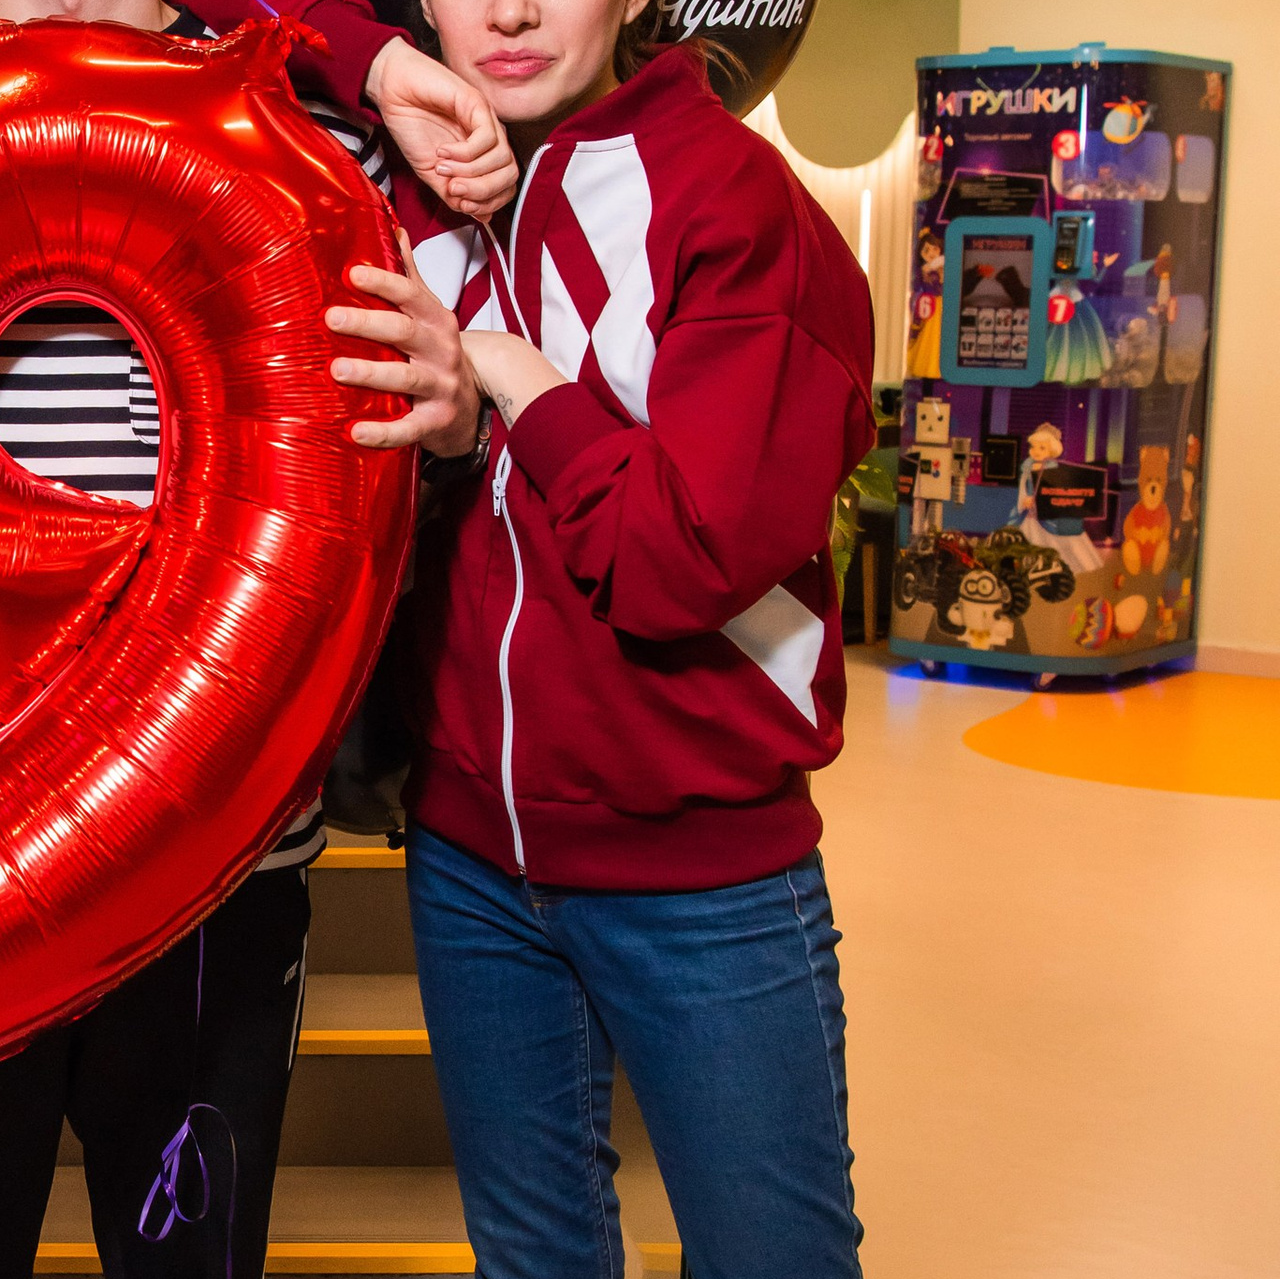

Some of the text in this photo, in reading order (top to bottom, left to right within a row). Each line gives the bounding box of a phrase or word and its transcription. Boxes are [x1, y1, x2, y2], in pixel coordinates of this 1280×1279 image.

[936, 86, 1077, 117] ИГРУШКИ
[1057, 133, 1077, 159] 3
[1052, 298, 1069, 322] 7
